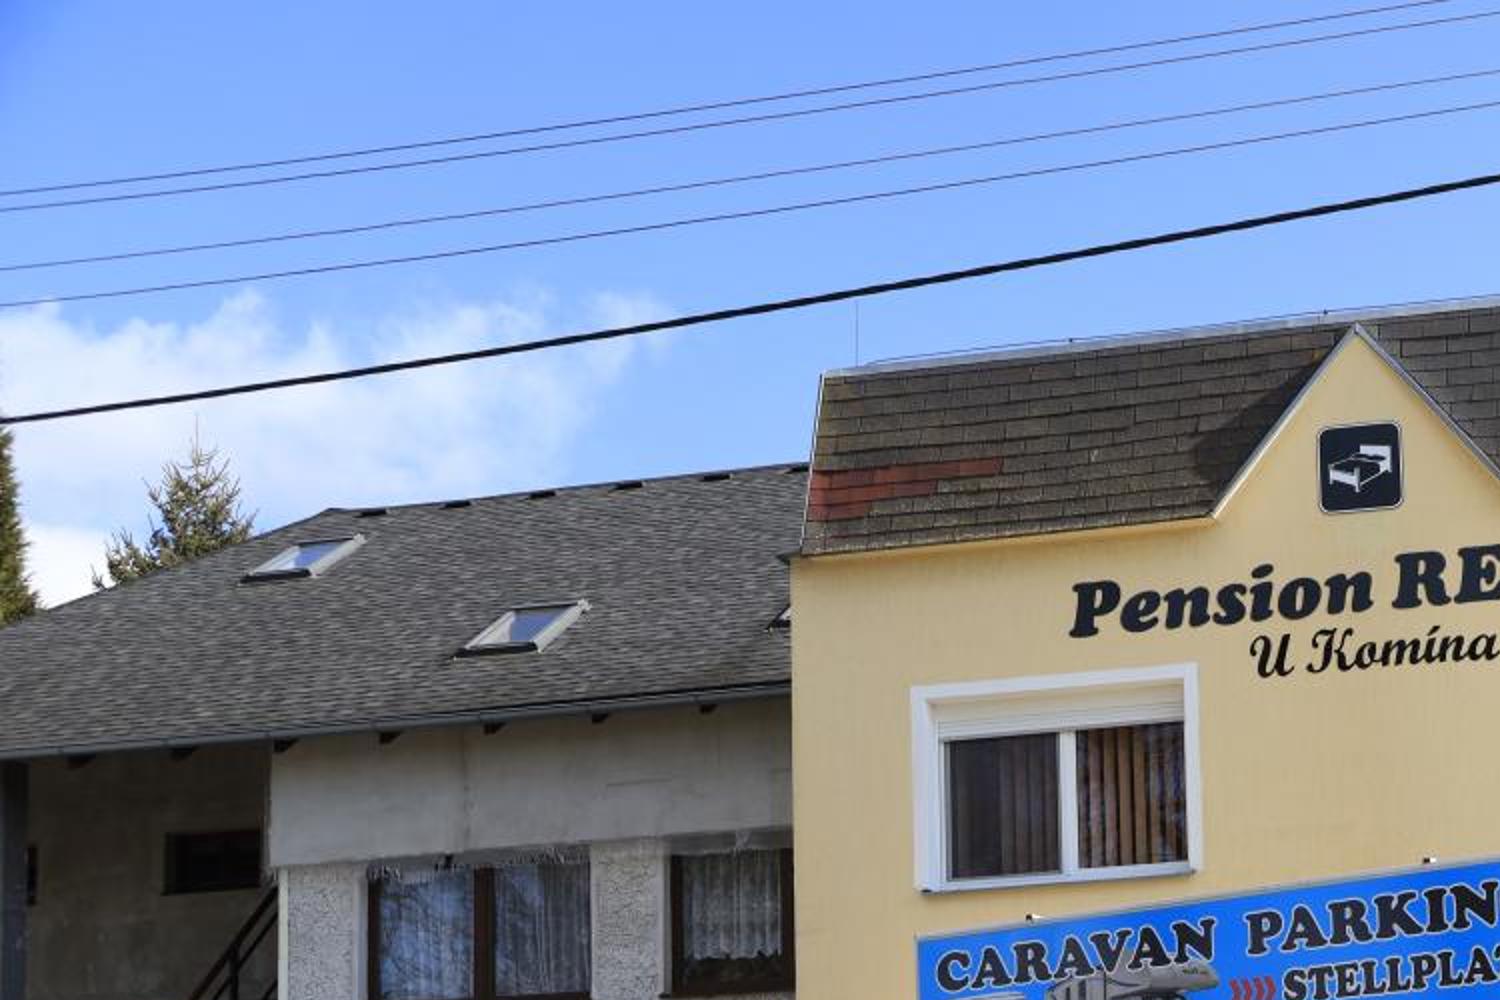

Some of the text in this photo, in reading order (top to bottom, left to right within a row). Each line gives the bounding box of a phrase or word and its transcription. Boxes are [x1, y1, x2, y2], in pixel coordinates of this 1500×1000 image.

[1069, 564, 1374, 638] Pension
[1250, 626, 1500, 678] U Komína
[936, 918, 1216, 992] CARAVAN
